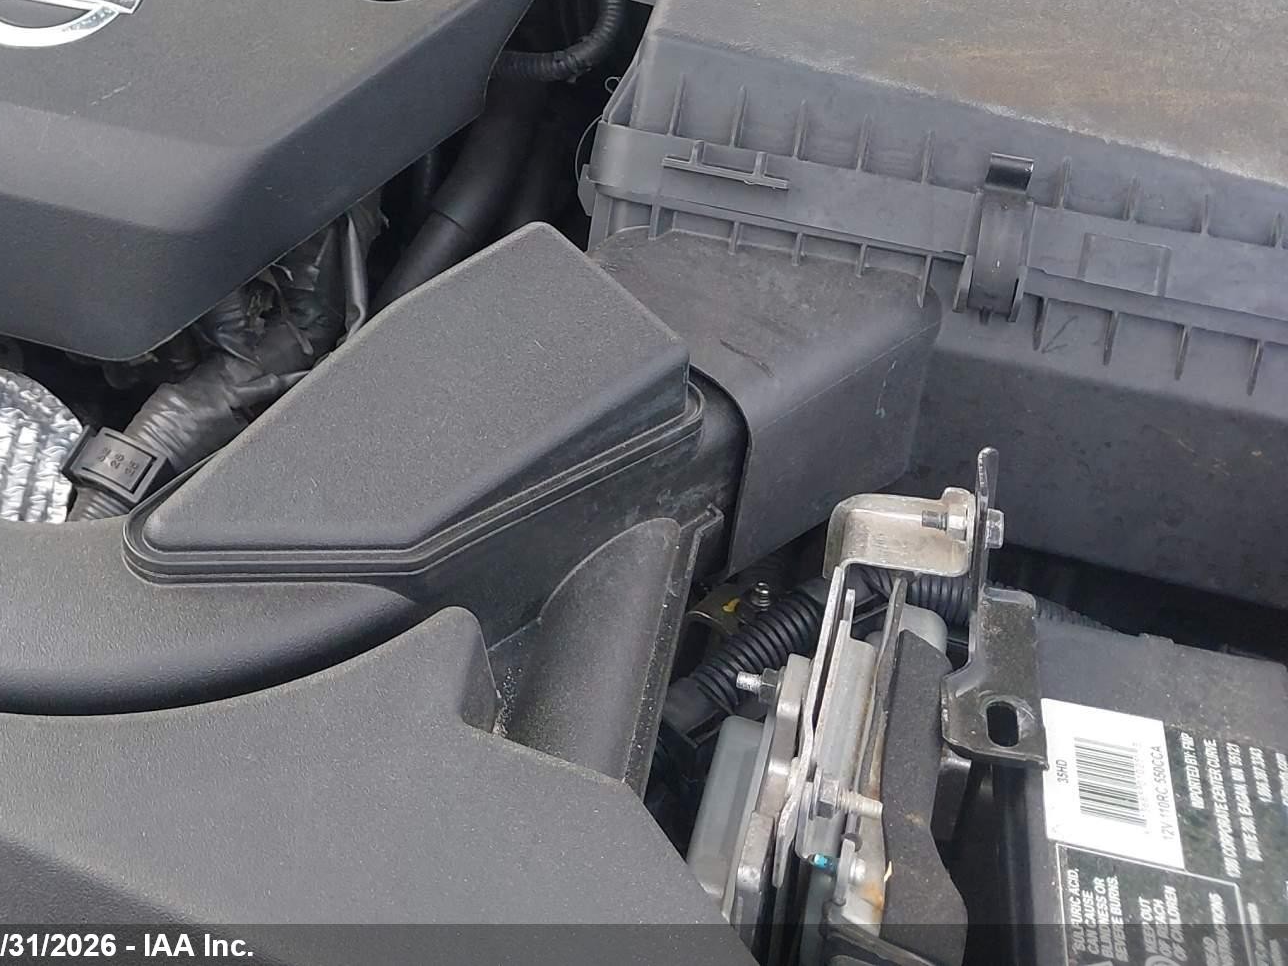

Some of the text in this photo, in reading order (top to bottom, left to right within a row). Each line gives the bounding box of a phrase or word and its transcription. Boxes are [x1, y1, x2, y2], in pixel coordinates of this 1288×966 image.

[1056, 758, 1070, 784] 35HD
[1150, 745, 1167, 784] 550CCA
[1180, 732, 1205, 809] IMPORTED BY: FMP
[1226, 742, 1243, 767] 55121
[1208, 768, 1227, 804] CENTER
[1160, 820, 1175, 841] 12V
[1214, 802, 1238, 858] CORPORATE
[1070, 896, 1086, 952] SULFURIC
[1081, 890, 1100, 954] CAN CAUSE
[1093, 876, 1114, 958] BLINDNESS OR
[1106, 875, 1129, 962] SEVERE BURNS.
[1138, 896, 1159, 954] KEEP OUT
[1152, 898, 1173, 956] OF REACH
[1163, 885, 1188, 962] OF CHILDREN
